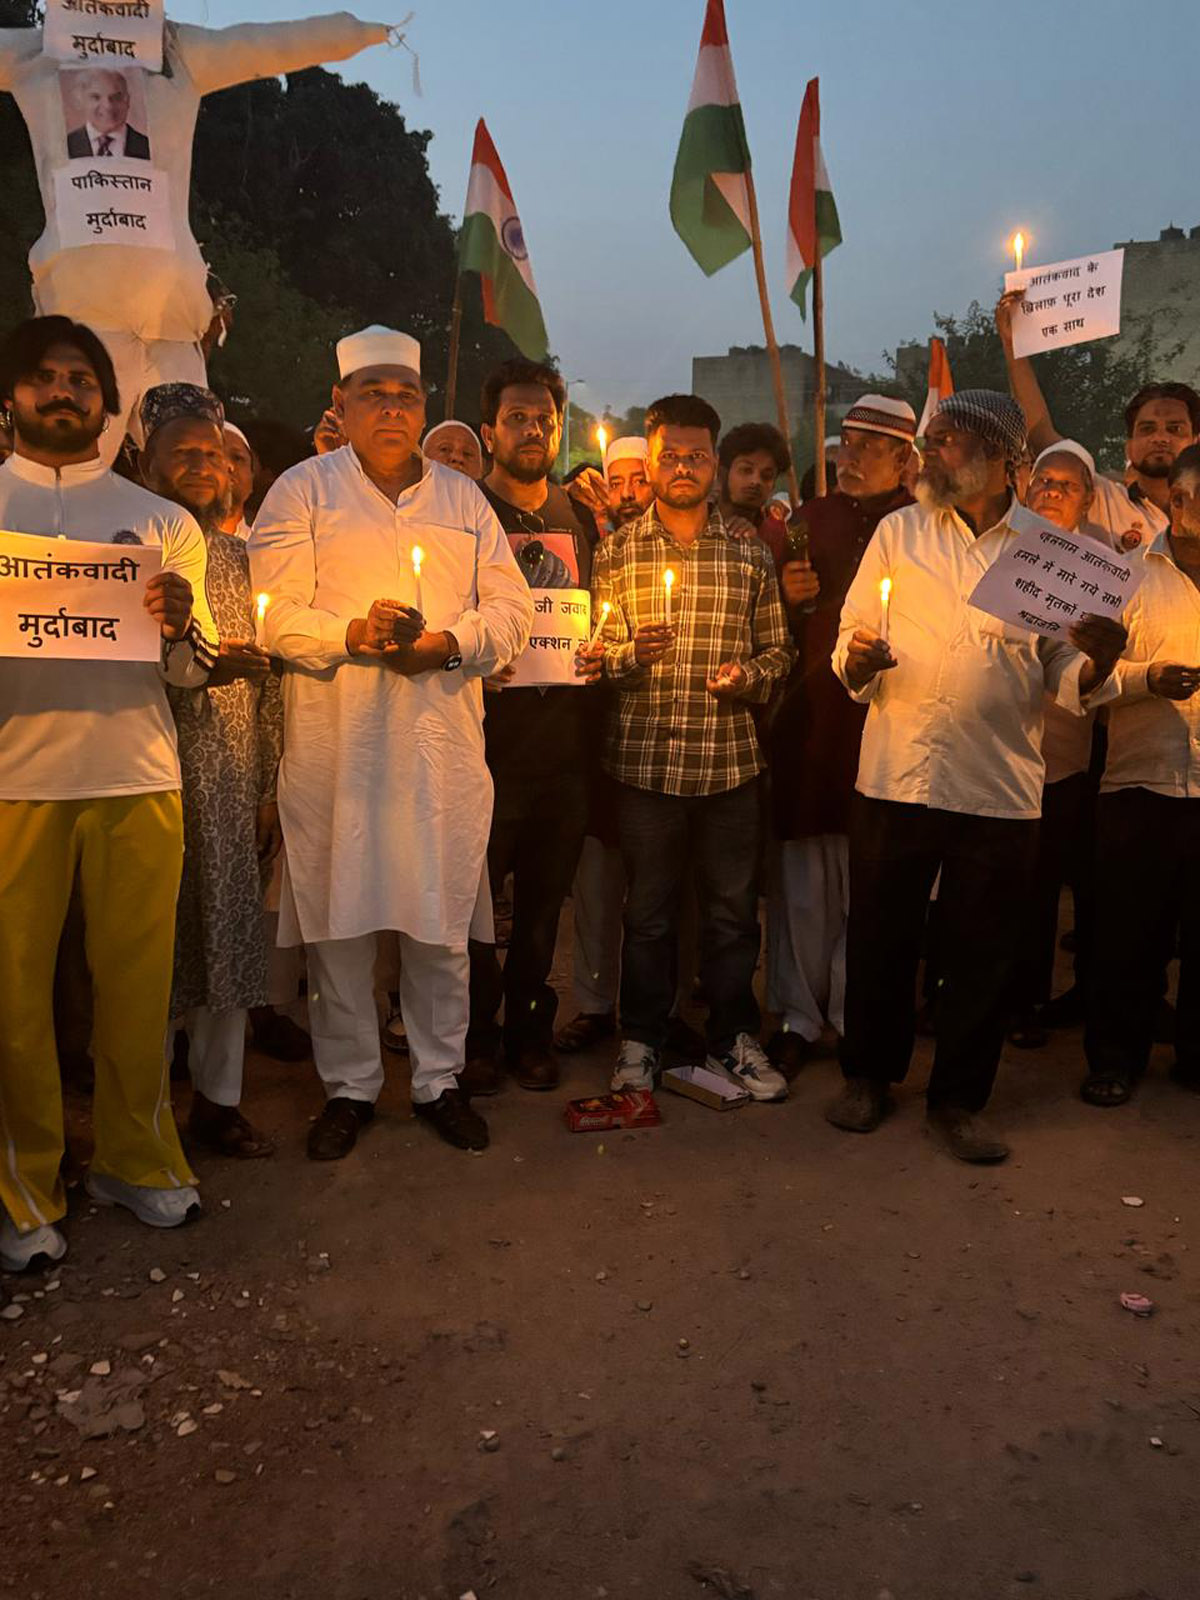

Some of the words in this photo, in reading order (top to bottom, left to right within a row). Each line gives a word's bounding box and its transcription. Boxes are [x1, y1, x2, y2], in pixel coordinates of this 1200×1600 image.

[62, 0, 149, 18] आतकवादी
[71, 32, 136, 59] मुर्दाबाद
[72, 170, 152, 192] पाकिस्तान
[86, 208, 147, 233] मुर्दाबाद
[1029, 267, 1081, 287] आतंकवाद
[1087, 261, 1099, 273] के
[1063, 291, 1081, 307] पूरा
[1087, 285, 1106, 299] देश
[1042, 324, 1058, 337] एक
[1064, 318, 1085, 332] साथ
[0, 552, 140, 583] आतंकवादी
[1081, 550, 1131, 582] आतंकवादी
[1013, 549, 1041, 567] हमले
[1042, 560, 1055, 573] में
[1057, 567, 1078, 585] मारे
[1080, 580, 1099, 596] गये
[1102, 591, 1122, 608] सभी
[1014, 577, 1042, 599] शहीद
[534, 596, 554, 614] जी
[18, 607, 120, 648] मुर्दाबाद
[528, 636, 573, 651] एक्शन
